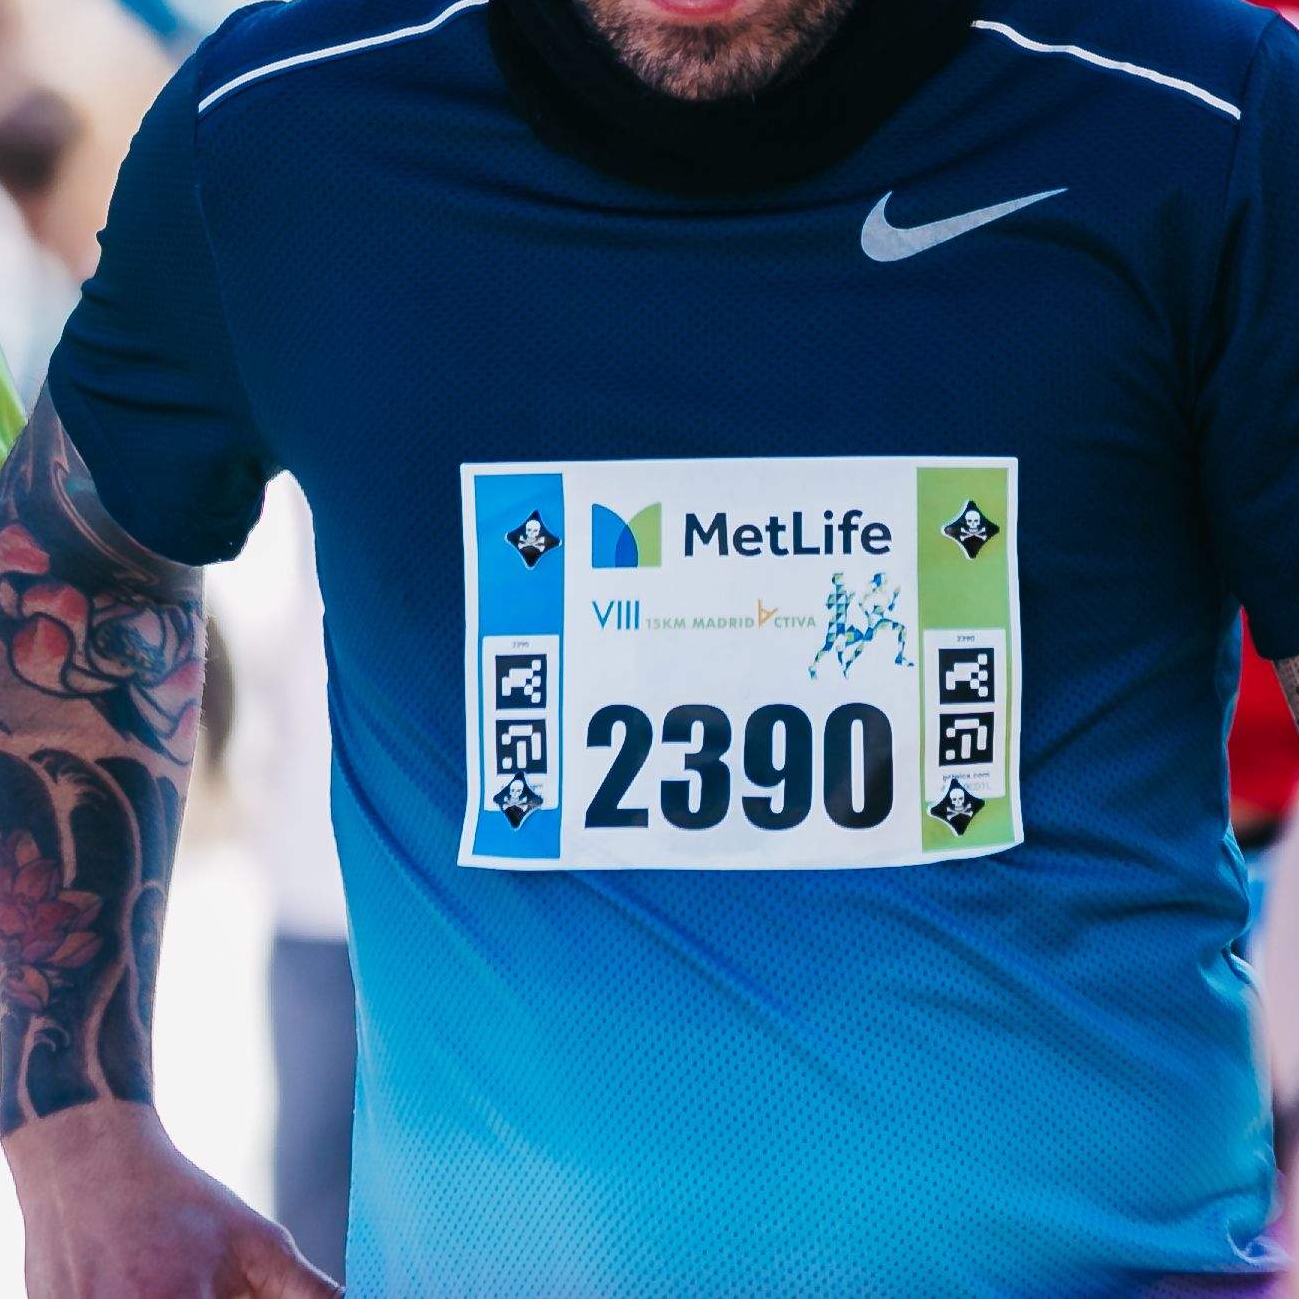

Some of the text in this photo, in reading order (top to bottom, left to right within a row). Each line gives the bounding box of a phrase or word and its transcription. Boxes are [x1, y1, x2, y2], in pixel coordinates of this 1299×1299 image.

[683, 509, 892, 557] MetLife
[591, 599, 640, 630] VIII
[646, 617, 687, 630] 15KM
[692, 617, 755, 630] MADRID
[584, 702, 894, 831] 2390
